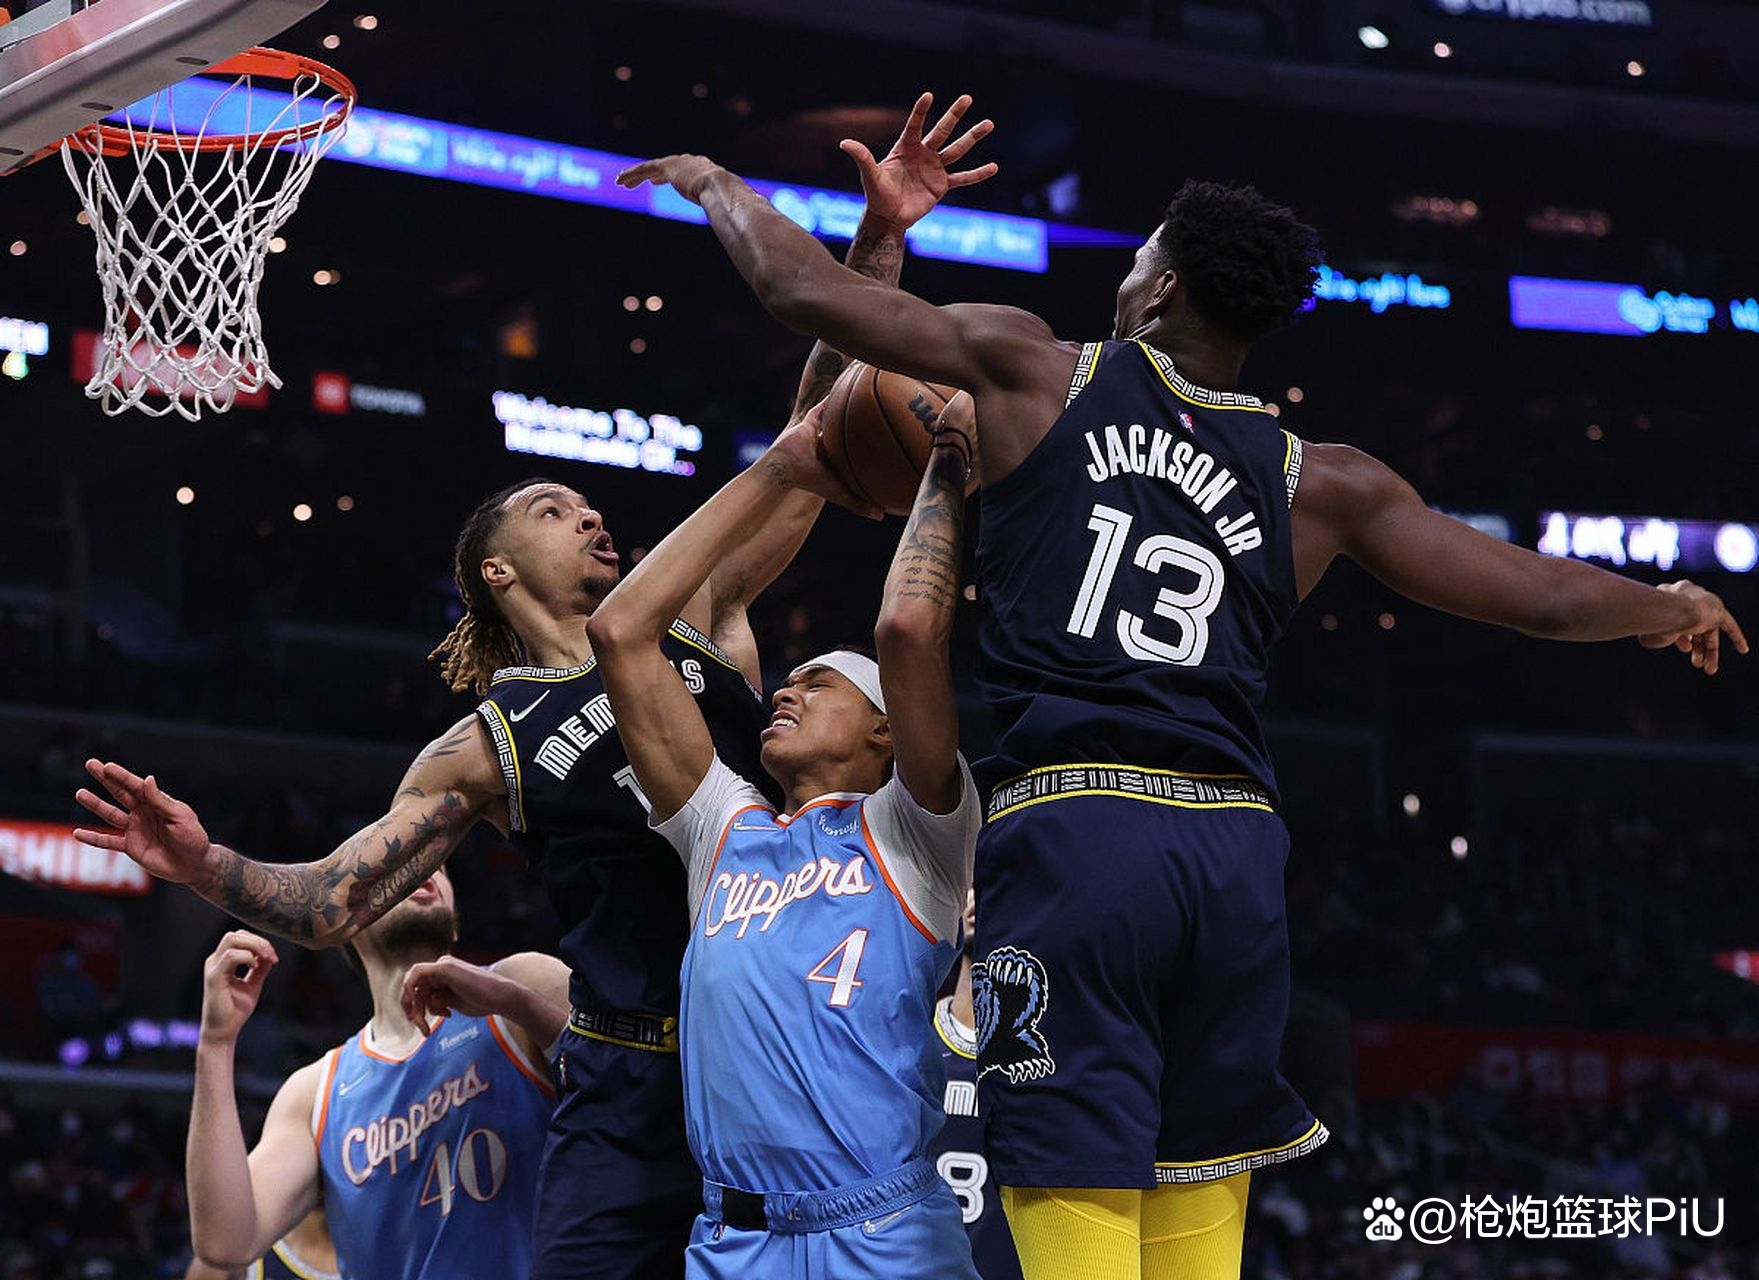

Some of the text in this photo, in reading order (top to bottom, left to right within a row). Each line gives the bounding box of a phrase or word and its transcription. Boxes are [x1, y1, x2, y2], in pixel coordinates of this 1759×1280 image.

[1084, 424, 1263, 556] JACKSON JR
[1066, 503, 1225, 667] 13
[704, 855, 874, 940] Clippers
[805, 928, 870, 1008] 4
[341, 1061, 491, 1186] Clippers
[419, 1128, 507, 1217] 40
